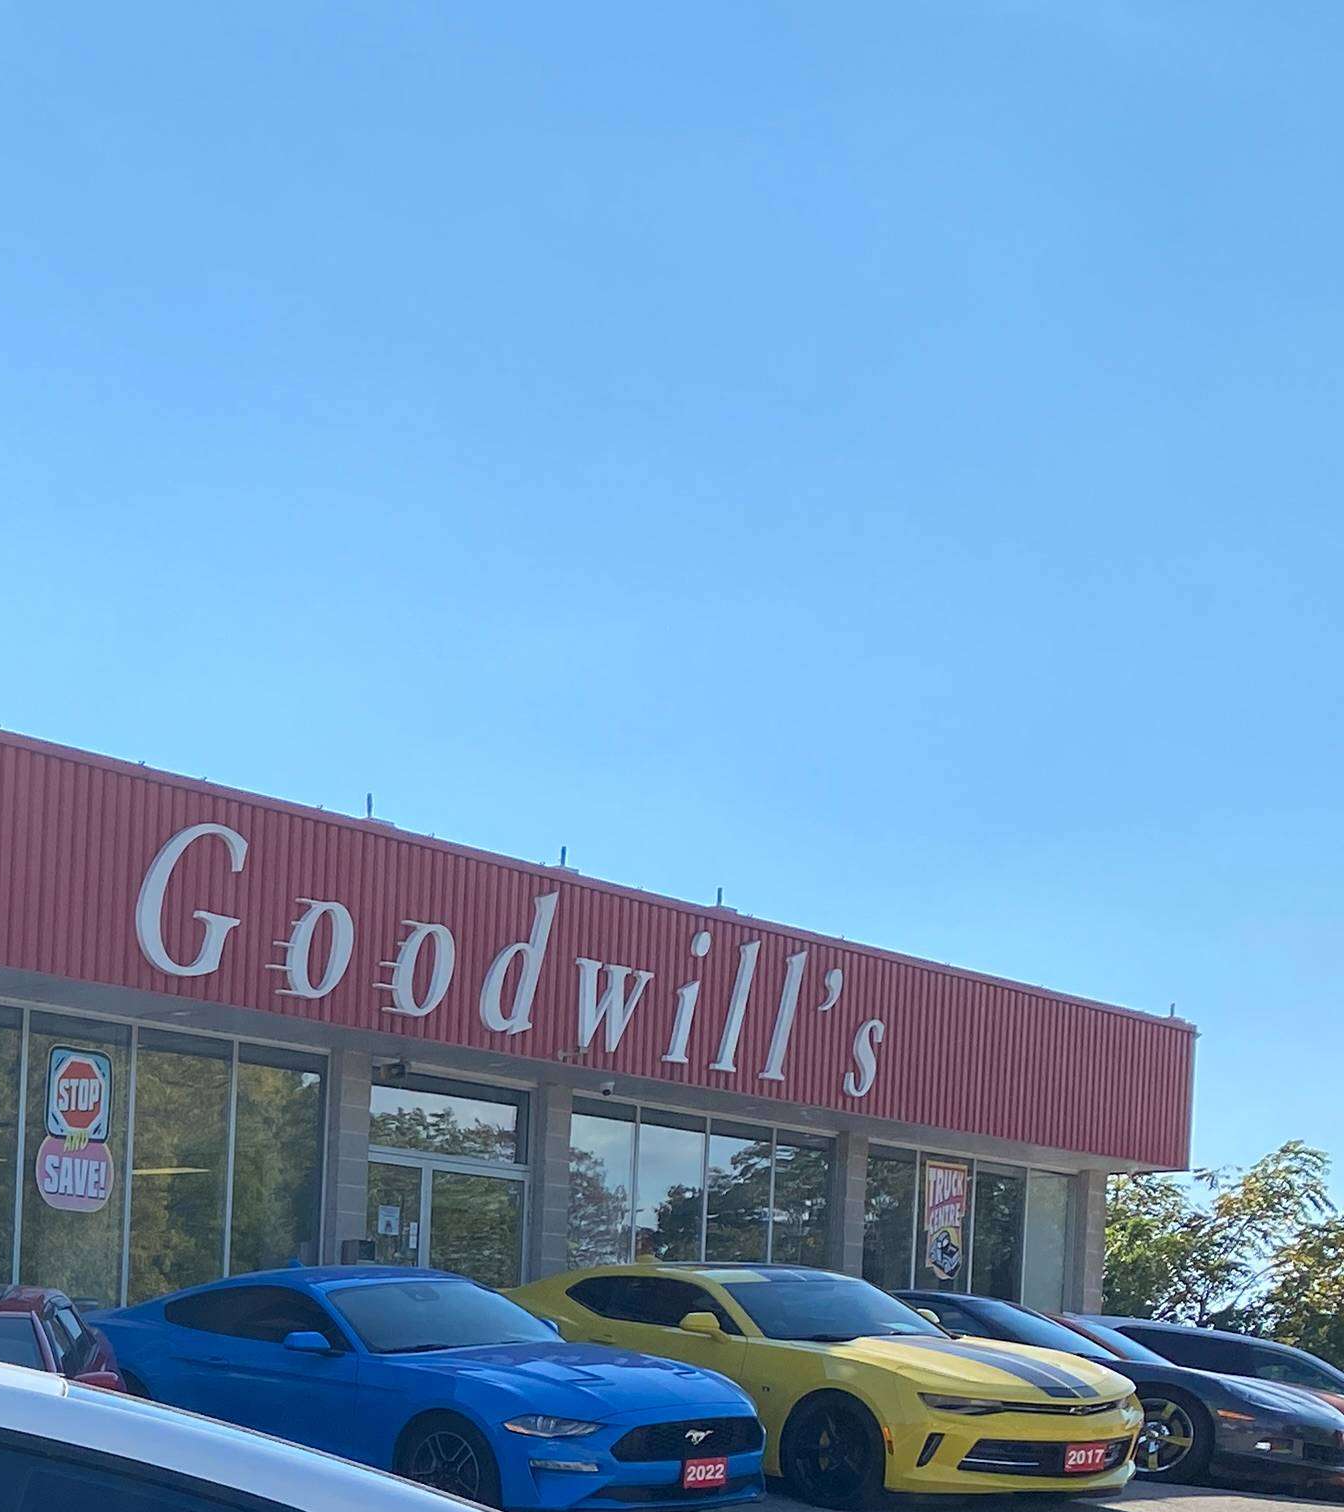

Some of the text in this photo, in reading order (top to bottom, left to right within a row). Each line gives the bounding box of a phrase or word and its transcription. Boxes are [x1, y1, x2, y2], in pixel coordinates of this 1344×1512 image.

[135, 822, 886, 1098] Goodwill's
[58, 1077, 100, 1112] STOP
[64, 1131, 89, 1152] AND
[43, 1154, 107, 1200] SAVE!
[928, 1167, 964, 1208] TRUCK
[929, 1202, 961, 1236] CENTRE
[687, 1463, 725, 1482] 2022
[1068, 1449, 1105, 1465] 2017
